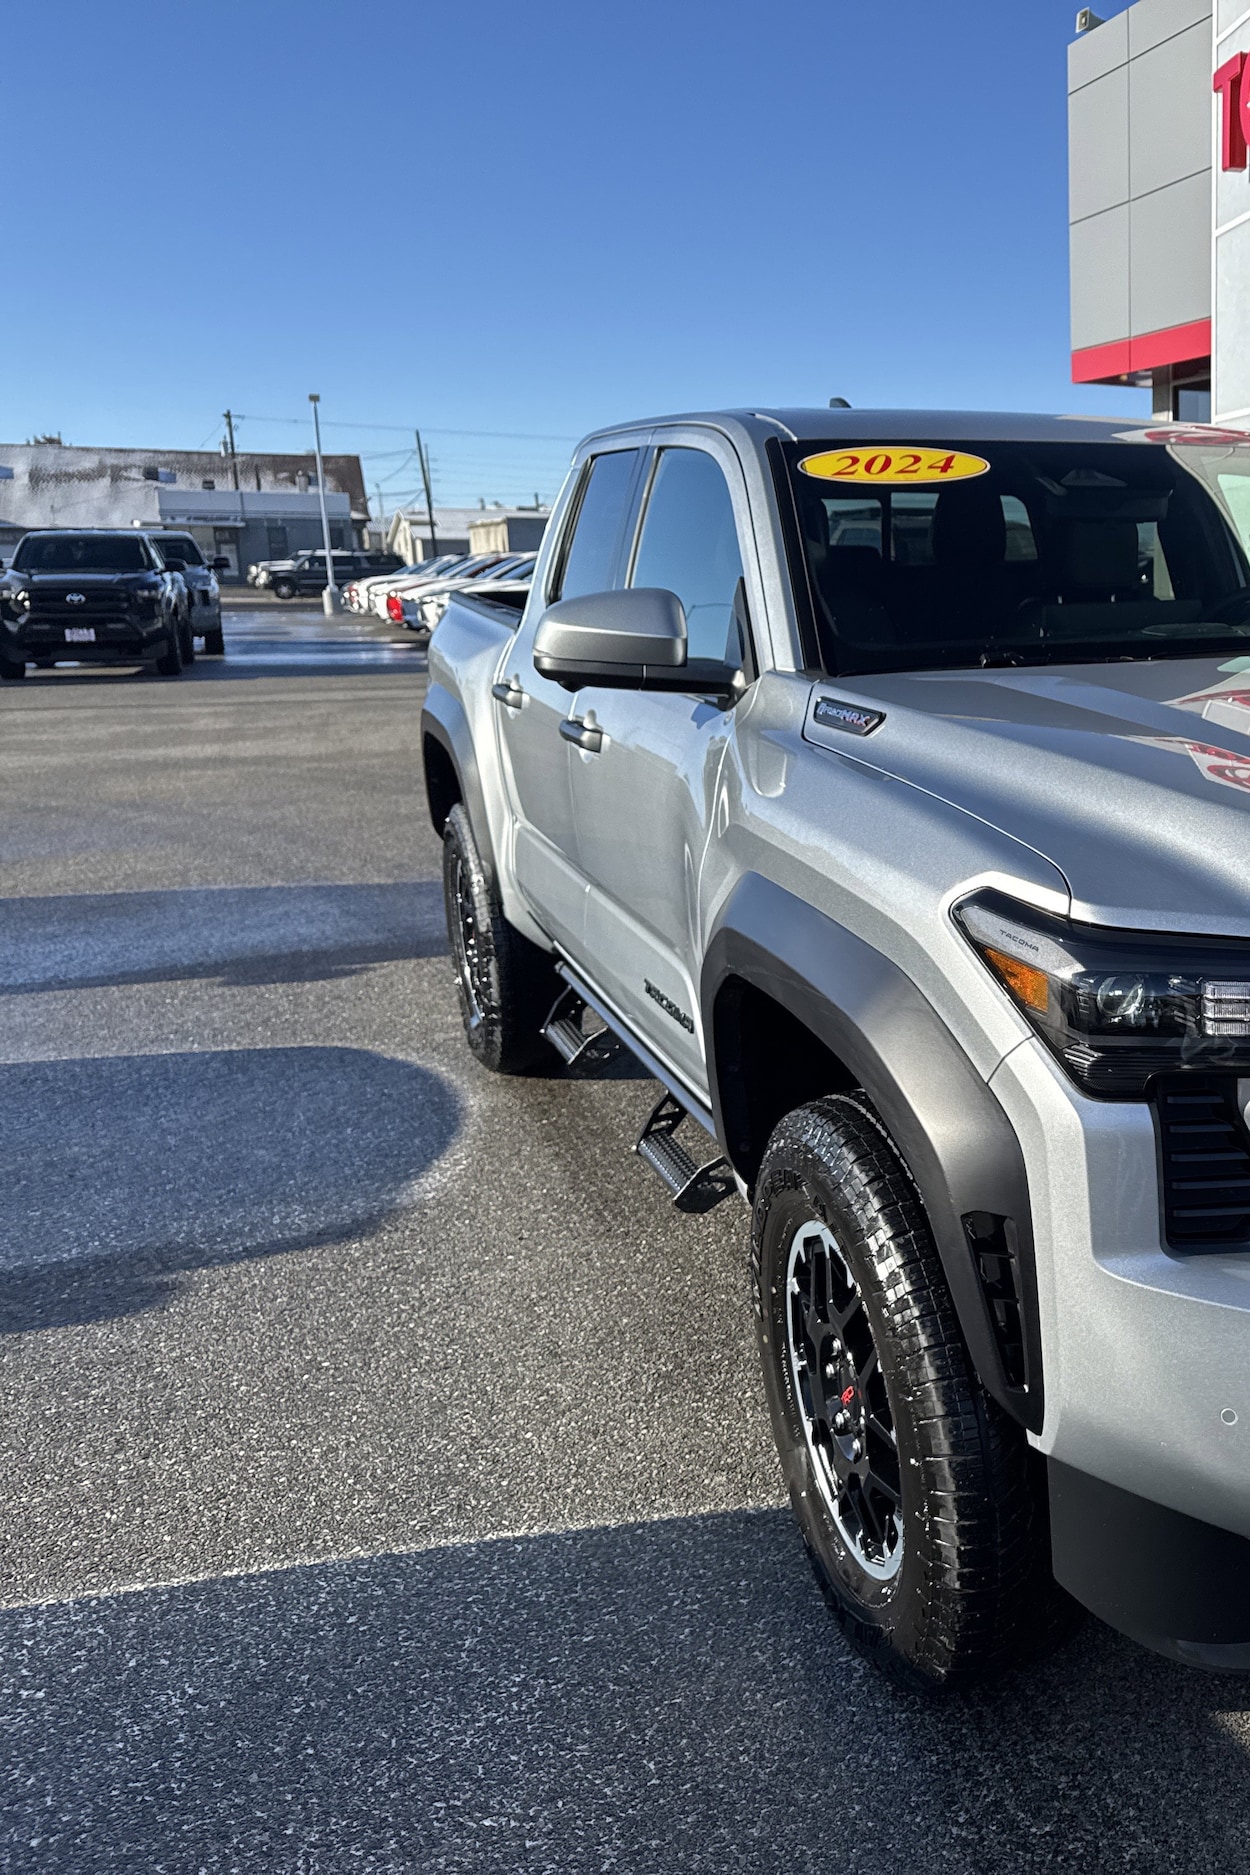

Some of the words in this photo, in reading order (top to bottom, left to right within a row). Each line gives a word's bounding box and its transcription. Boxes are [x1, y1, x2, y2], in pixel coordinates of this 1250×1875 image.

[831, 453, 956, 476] 2024
[1000, 929, 1039, 952] TACOMA
[643, 977, 694, 1034] TACOMA
